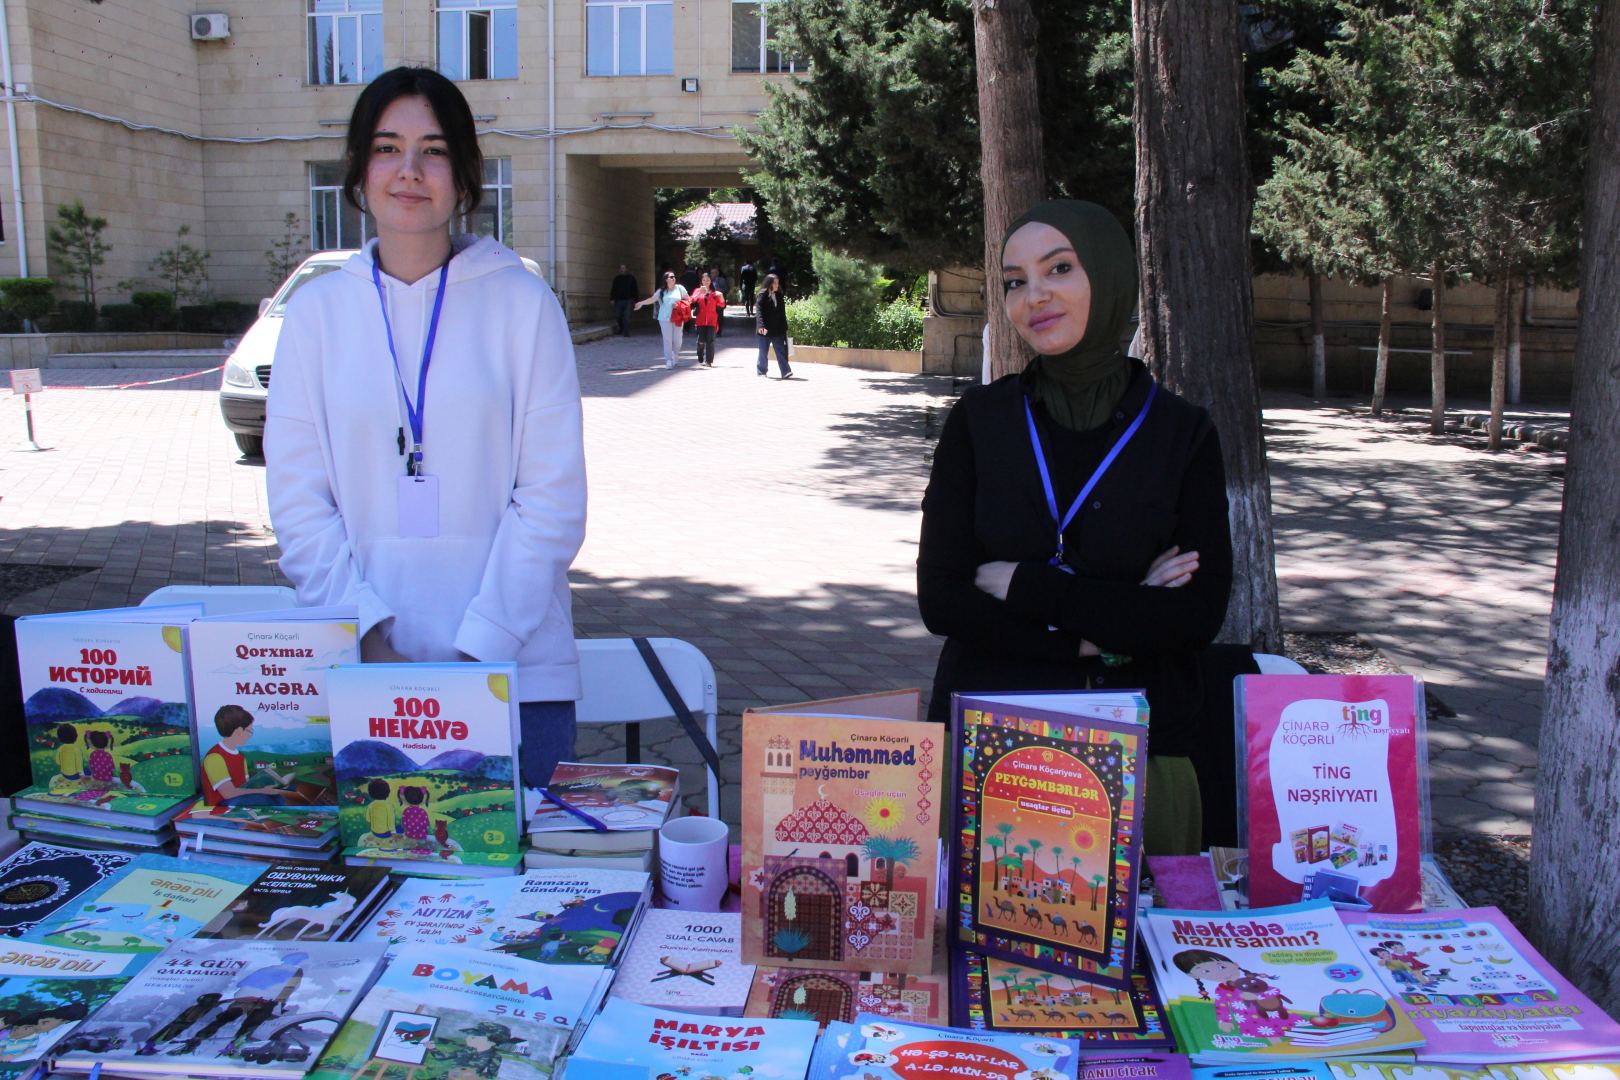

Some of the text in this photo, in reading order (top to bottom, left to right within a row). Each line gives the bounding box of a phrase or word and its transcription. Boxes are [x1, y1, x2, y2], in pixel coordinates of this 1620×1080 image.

[80, 648, 117, 665] 100
[235, 644, 314, 660] Qorxmaz
[49, 665, 152, 686] ИСТОРИЙ
[261, 663, 287, 677] bir
[235, 682, 319, 696] MACƏRA
[257, 701, 300, 712] Ayələrlə
[393, 696, 440, 718] 100
[1342, 705, 1382, 726] ting
[368, 717, 469, 741] HEKAYƏ
[1282, 720, 1329, 734] ÇİNARƏ
[850, 734, 909, 744] Çinarə Köçərli
[799, 739, 917, 766] Muhəmməd
[1012, 760, 1038, 771] Çinarə
[1312, 763, 1351, 779] TİNG
[995, 771, 1099, 801] PEYĞƏMBƏRLƏR
[1287, 786, 1378, 806] NƏŞRİYYATI
[266, 871, 346, 883] ОДУВАНЧИКИ
[150, 879, 192, 893] ƏRƏB
[412, 907, 474, 920] AUTİZM
[684, 924, 723, 934] 1000
[1172, 919, 1285, 938] Məktəbə
[1171, 930, 1320, 949] hazırsanmı?
[164, 957, 248, 969] 44 GÜN
[1329, 967, 1361, 980] 5+
[411, 963, 553, 1001] BOYAMA
[653, 1018, 765, 1038] MARYA
[648, 1030, 761, 1053] İŞILTISI
[901, 1048, 1019, 1071] HƏ-ŞƏ-RAT-LAR
